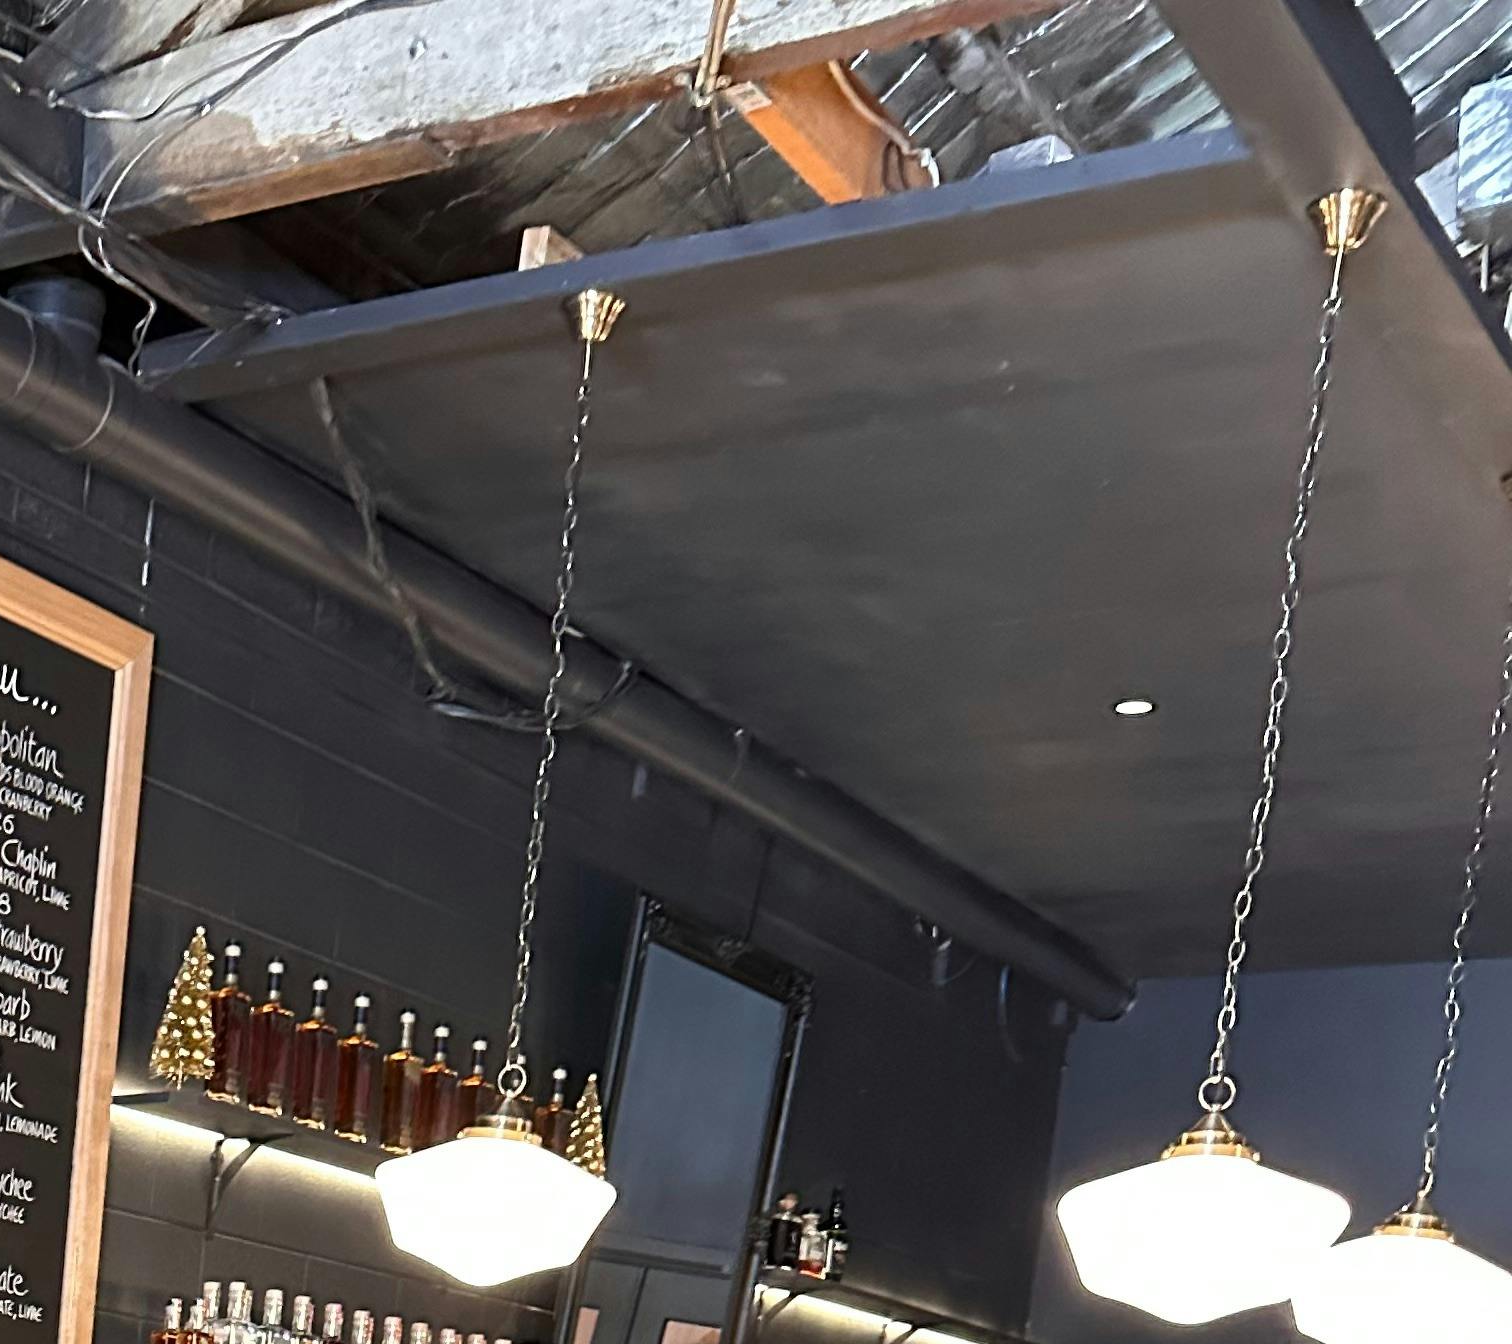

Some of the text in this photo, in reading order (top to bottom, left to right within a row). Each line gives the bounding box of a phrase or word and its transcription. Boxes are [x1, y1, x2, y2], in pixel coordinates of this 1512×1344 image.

[14, 767, 44, 796] BLOOD
[46, 781, 84, 815] ORANGE
[1, 838, 57, 880] Chaplin
[43, 885, 71, 911] LIME
[20, 1024, 56, 1050] LEMON
[5, 1113, 58, 1143] LEMONADE
[18, 1303, 43, 1322] LIME
